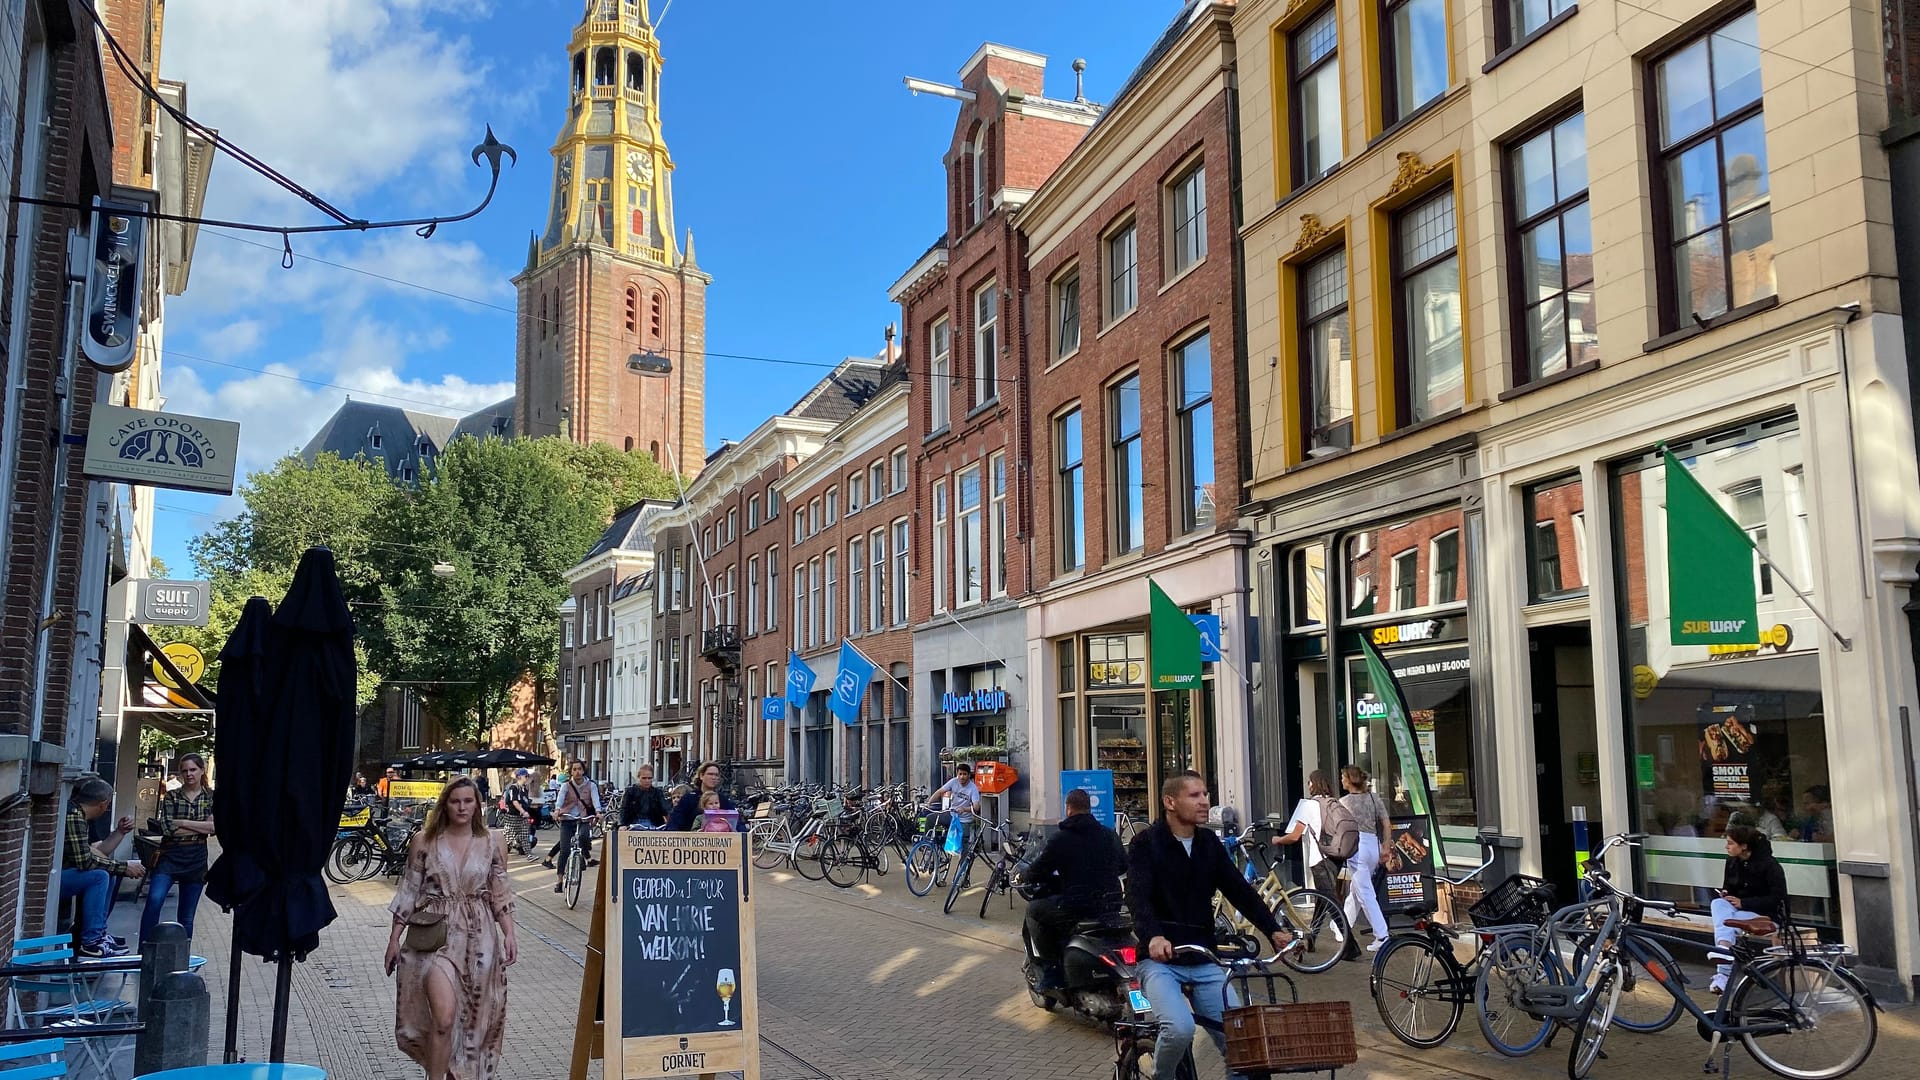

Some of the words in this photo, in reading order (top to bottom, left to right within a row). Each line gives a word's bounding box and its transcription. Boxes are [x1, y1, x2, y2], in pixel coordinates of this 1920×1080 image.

[109, 417, 148, 448] CAVE
[154, 416, 216, 460] OPORTO
[156, 589, 190, 604] SUIT
[155, 606, 190, 616] supply
[1373, 620, 1435, 645] SUBWAY
[1681, 619, 1747, 634] SUBWAY
[1158, 674, 1196, 683] SUBWAY
[942, 691, 974, 714] Albert
[976, 688, 1006, 715] Heijn
[1356, 700, 1388, 717] Open
[1712, 766, 1748, 776] SMOKY
[628, 836, 667, 847] PORTUGEES
[667, 836, 690, 848] GETINT
[691, 837, 732, 848] RESTAURANT
[634, 848, 670, 865] CAVE
[672, 848, 726, 865] OPORTO
[632, 877, 676, 899] GEOPEND
[1386, 874, 1421, 885] SMOKY
[635, 903, 669, 932] VAN
[638, 935, 706, 961] WELKOM!
[662, 1053, 706, 1072] CORNET
